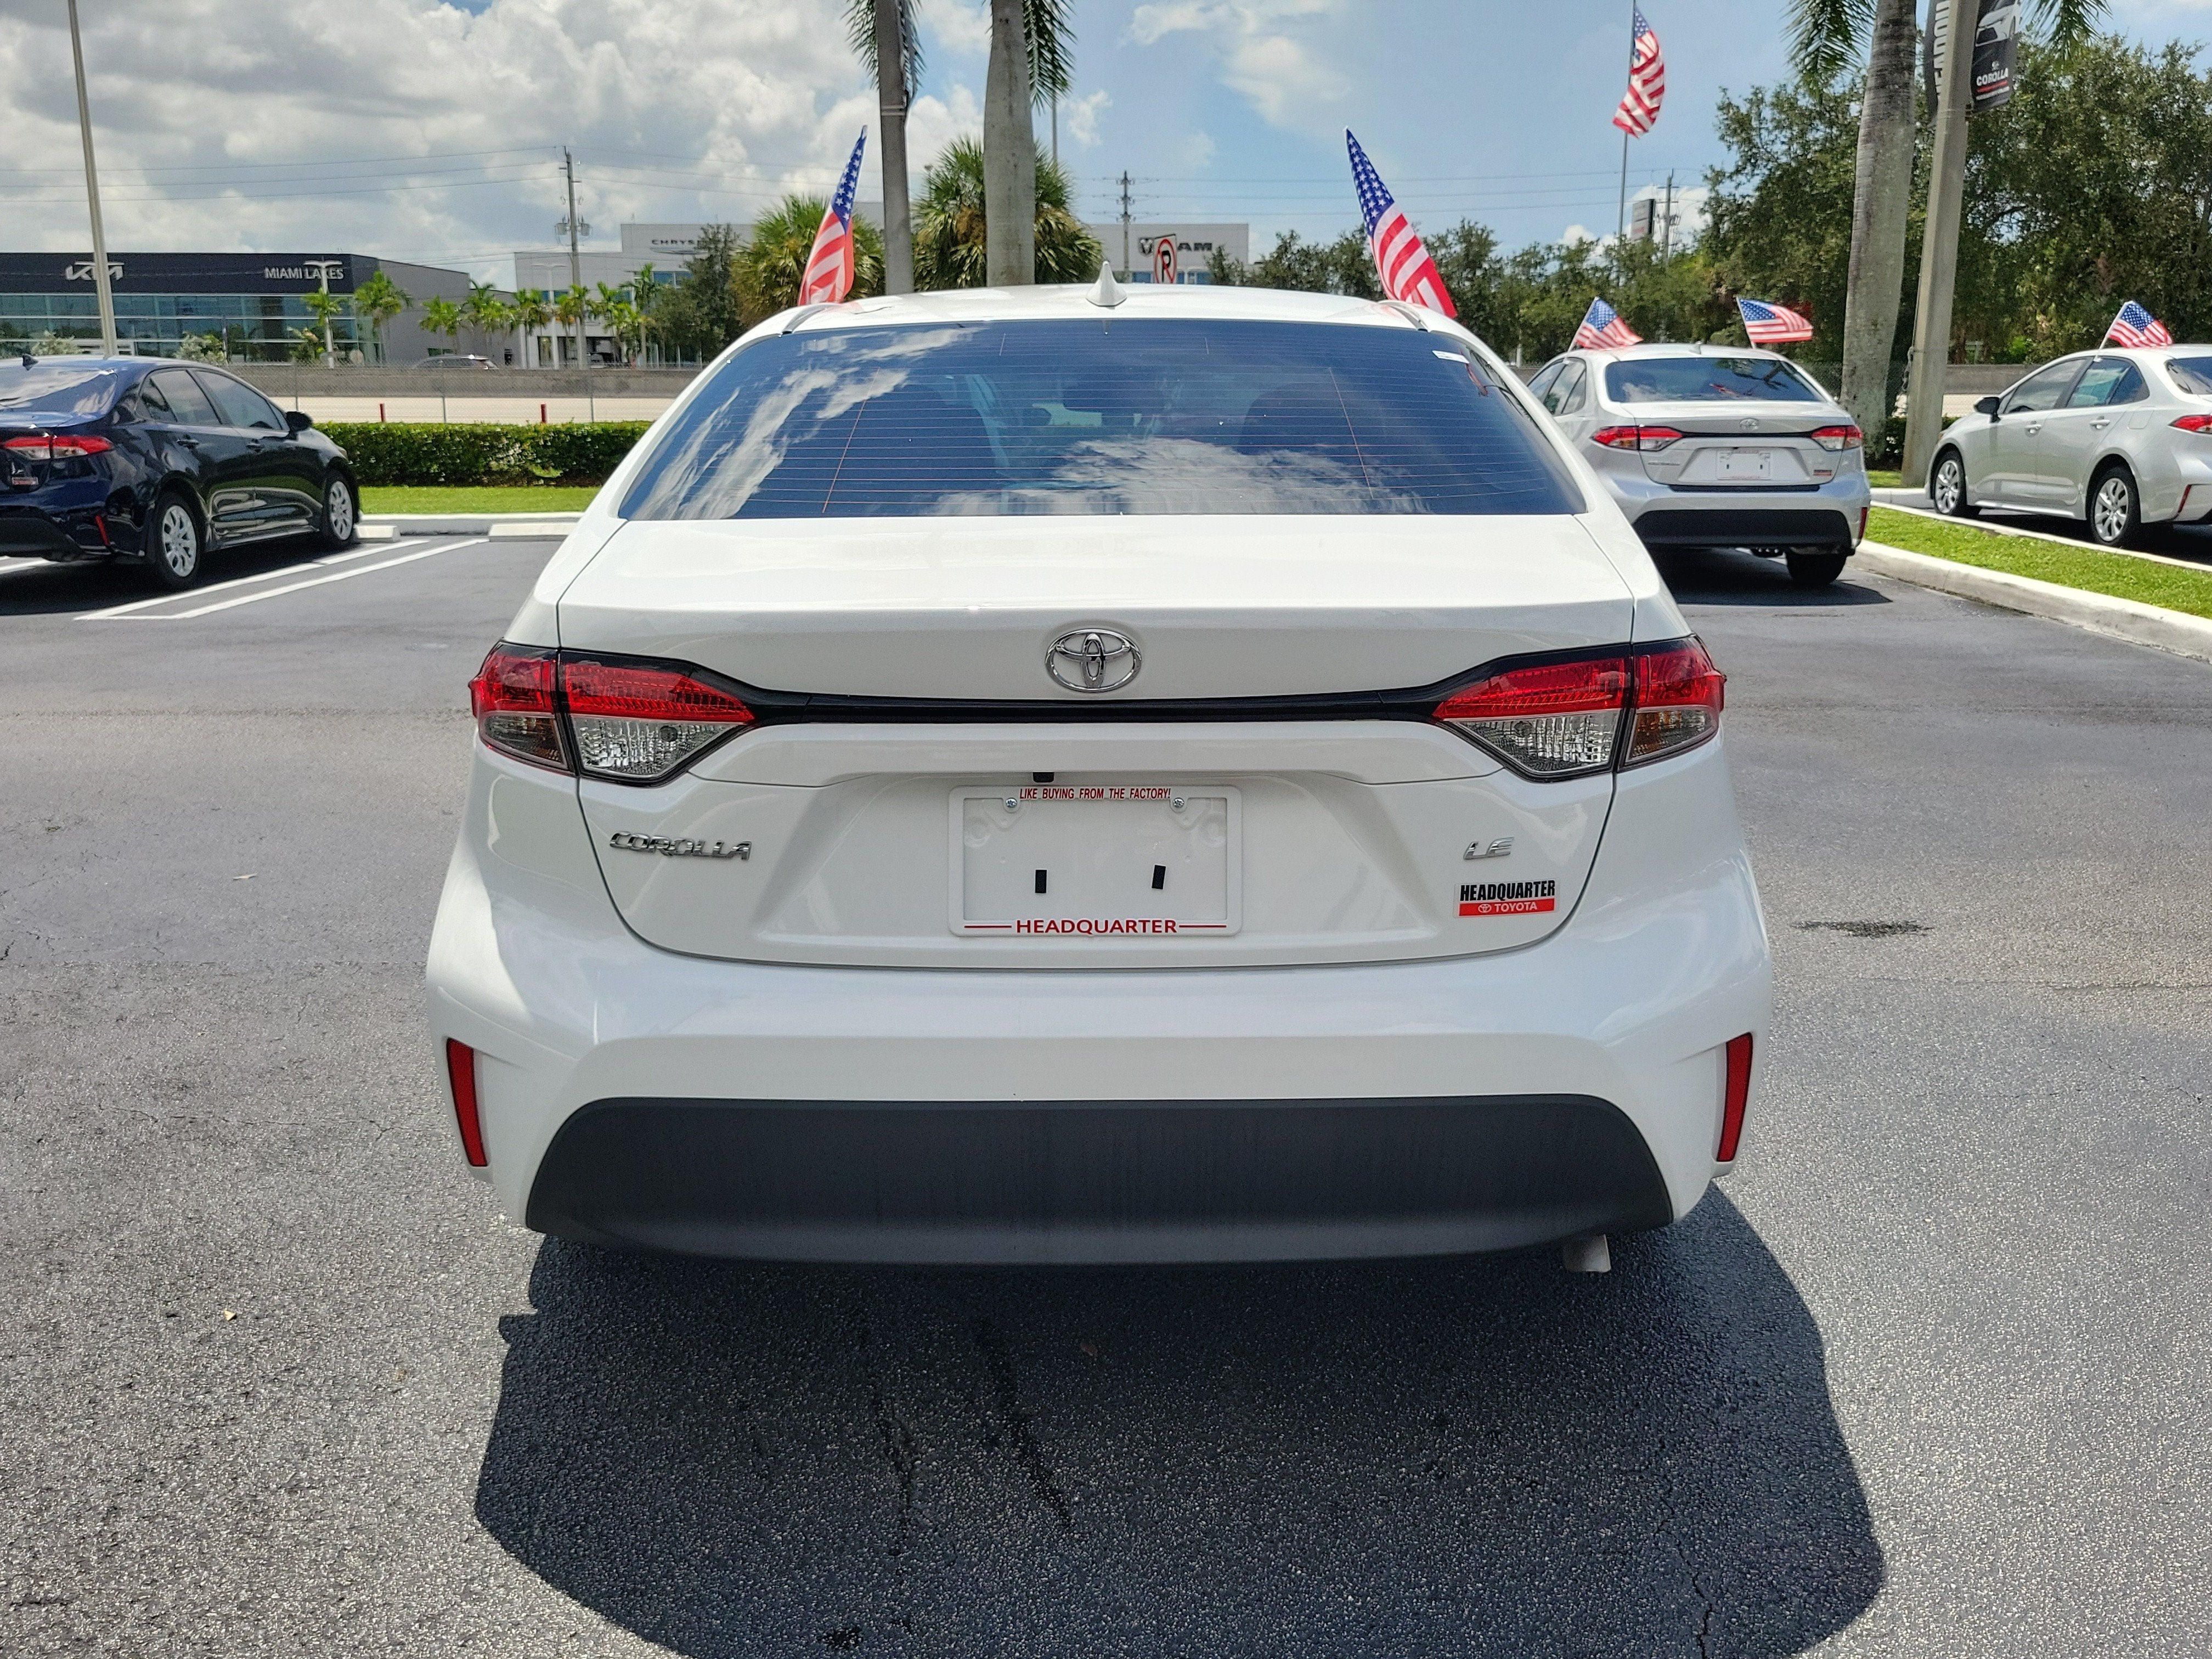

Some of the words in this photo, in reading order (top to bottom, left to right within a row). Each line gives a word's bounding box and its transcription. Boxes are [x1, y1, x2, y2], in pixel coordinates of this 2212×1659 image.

[1976, 67, 2008, 86] COROLLA
[1177, 242, 1212, 251] AM
[65, 265, 124, 280] KA
[264, 267, 302, 279] MIAMI
[1019, 788, 1037, 799] LIKE
[1042, 788, 1075, 799] BUYING
[1079, 788, 1104, 799] FROM
[1109, 788, 1125, 799] THE
[1129, 788, 1171, 799] FACTORY!
[610, 831, 752, 861] COROLLA
[1463, 836, 1515, 860] LE
[1459, 879, 1556, 901] HEADQUARTER
[1494, 901, 1538, 913] TOYOTA
[1016, 919, 1177, 935] HEADQUARTER
